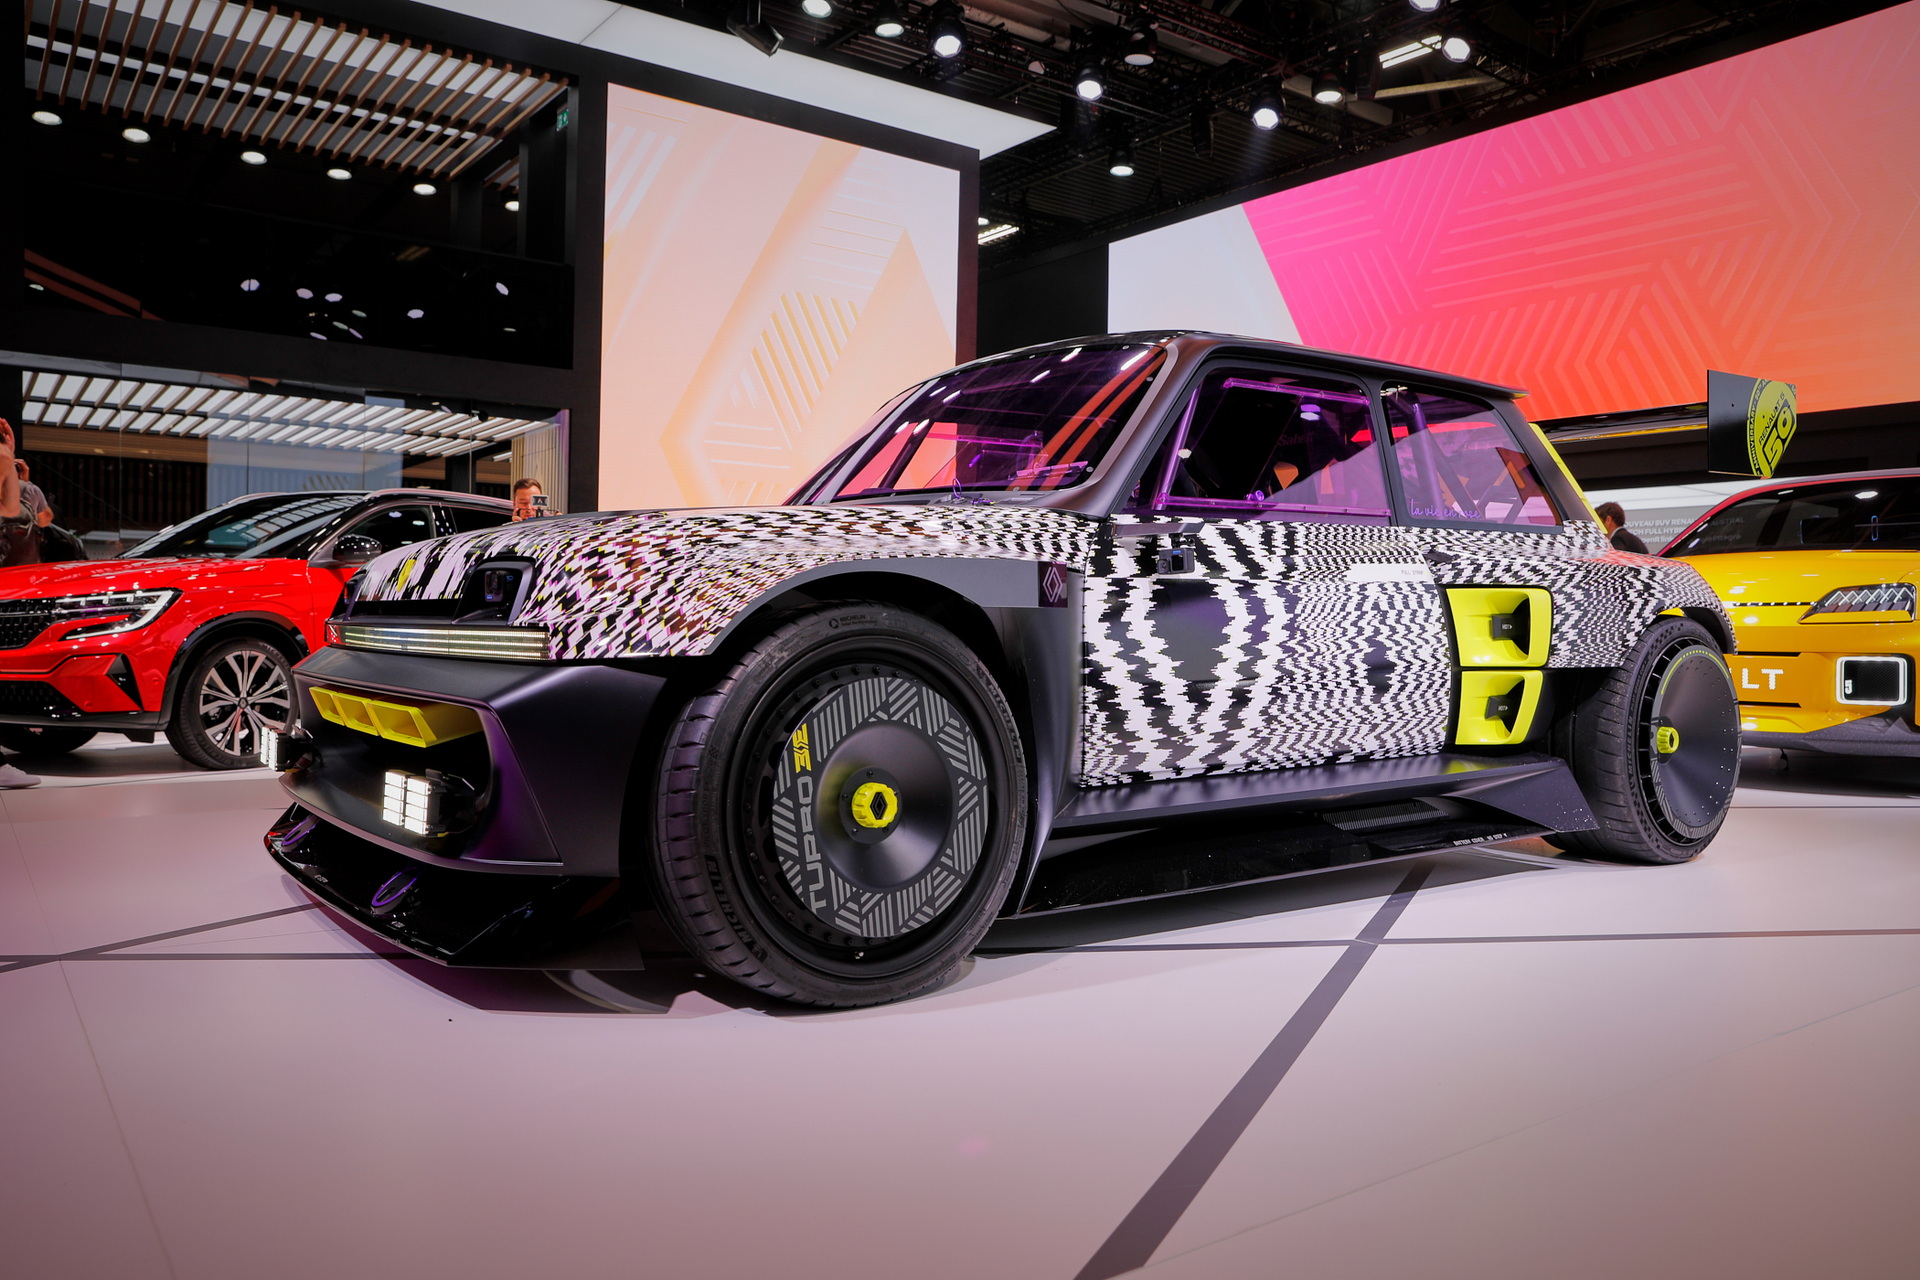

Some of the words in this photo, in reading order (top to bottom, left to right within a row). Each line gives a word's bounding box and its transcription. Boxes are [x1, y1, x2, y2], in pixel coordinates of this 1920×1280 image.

[1655, 518, 1671, 527] SUV
[839, 614, 866, 622] MICHELIN
[988, 684, 1022, 759] MICHELIN
[797, 775, 828, 914] TURBO
[707, 858, 751, 946] MICHELIN
